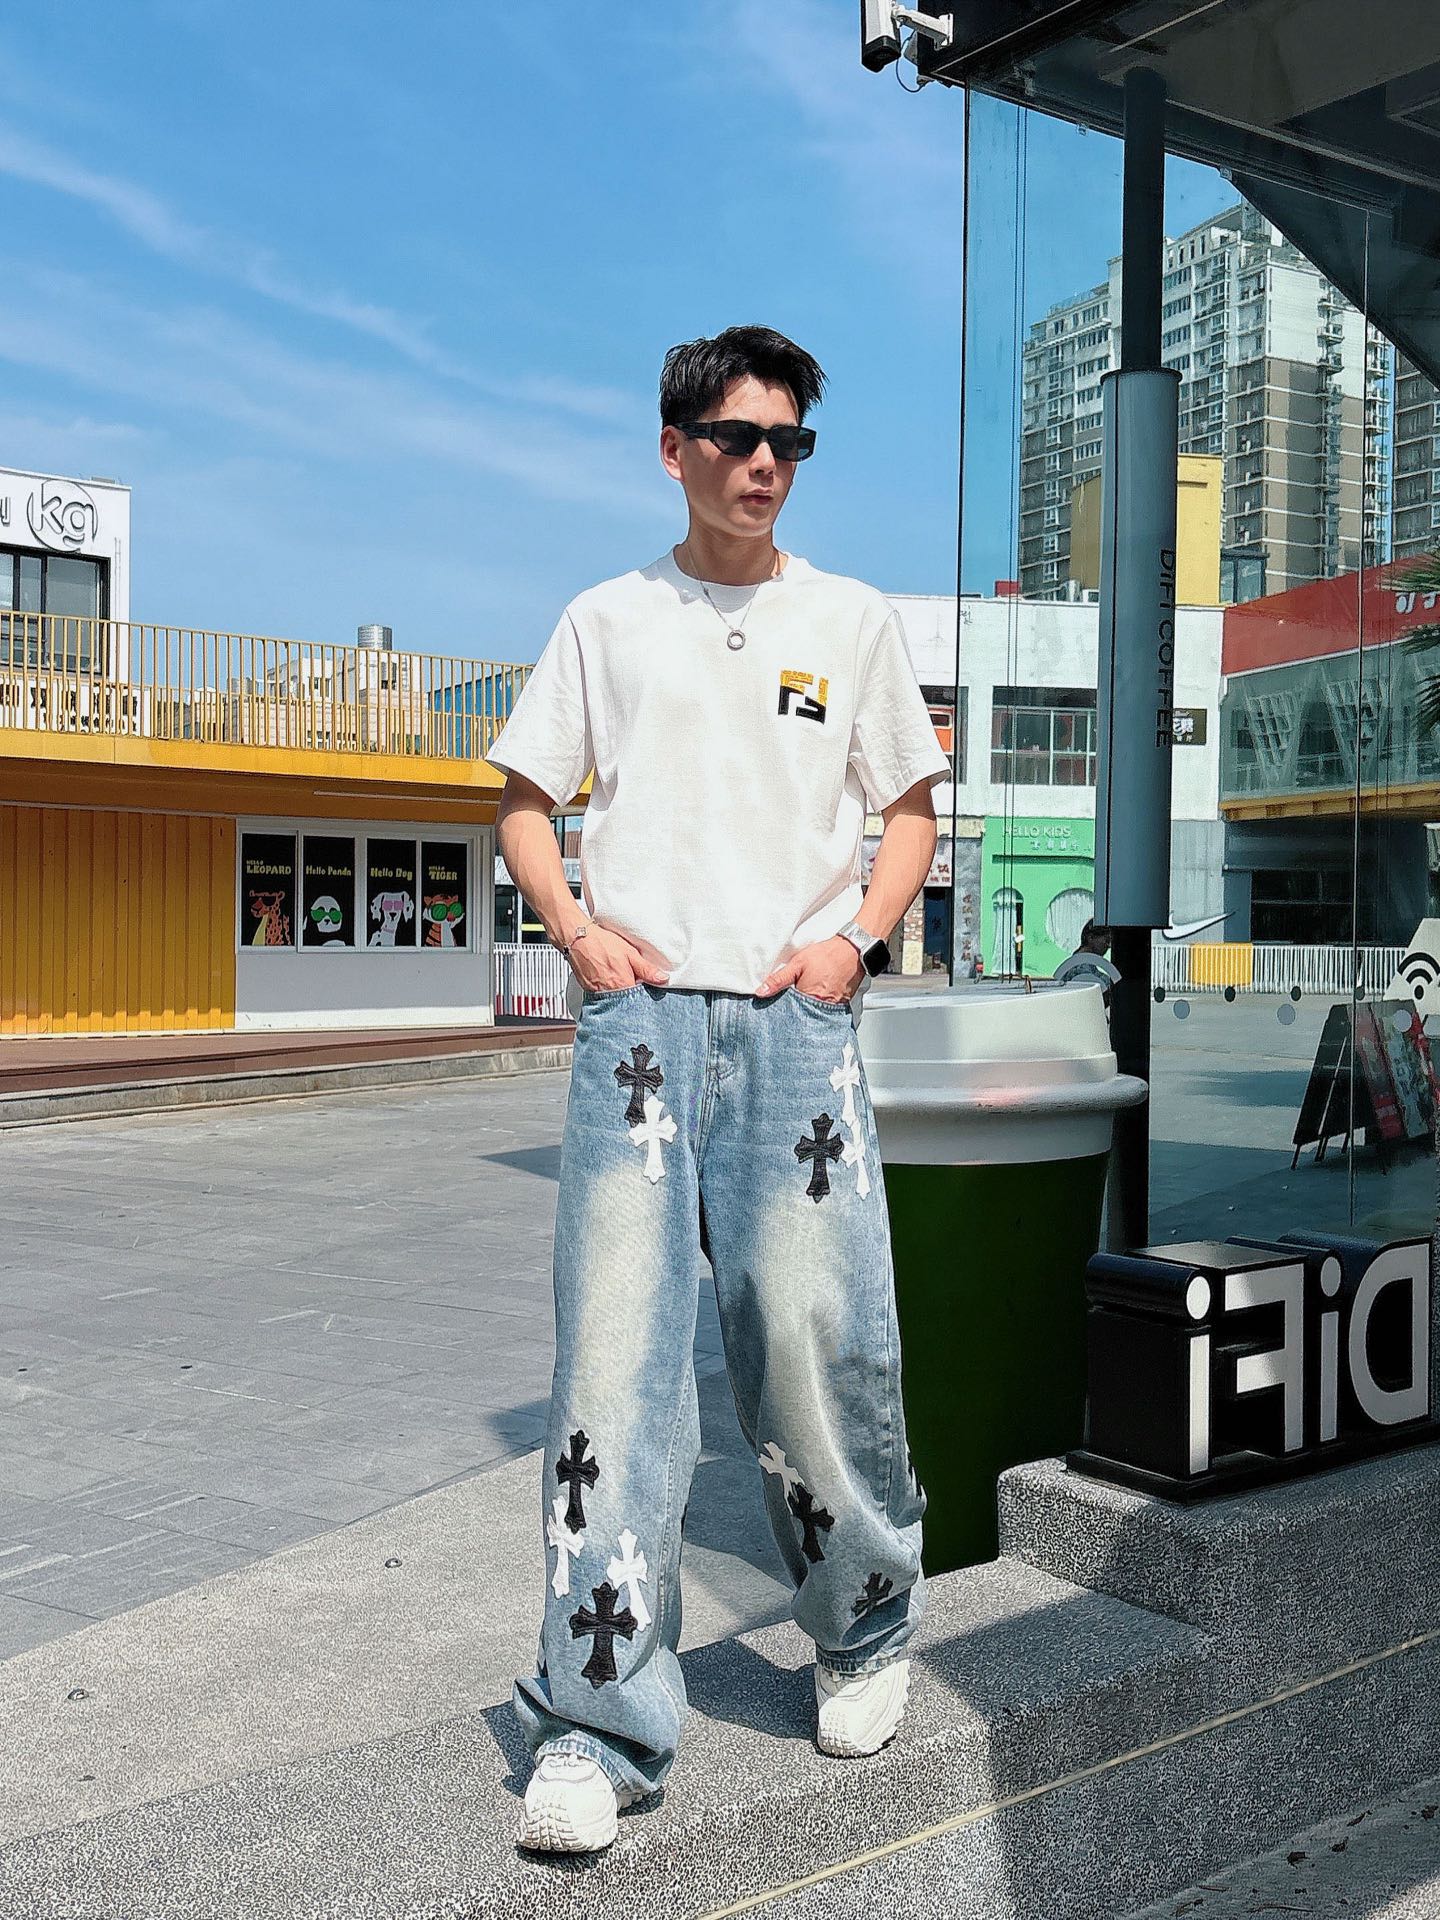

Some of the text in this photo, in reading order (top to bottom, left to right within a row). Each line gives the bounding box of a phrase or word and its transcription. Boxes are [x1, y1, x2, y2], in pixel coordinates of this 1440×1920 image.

[31, 481, 95, 549] kg
[1156, 619, 1174, 748] COFFEE
[1003, 826, 1072, 838] HELLO KIDS
[246, 865, 292, 875] LEOPARD
[305, 865, 352, 876] Hello Panda
[370, 867, 413, 881] Hello Dog
[429, 871, 457, 880] TIGER
